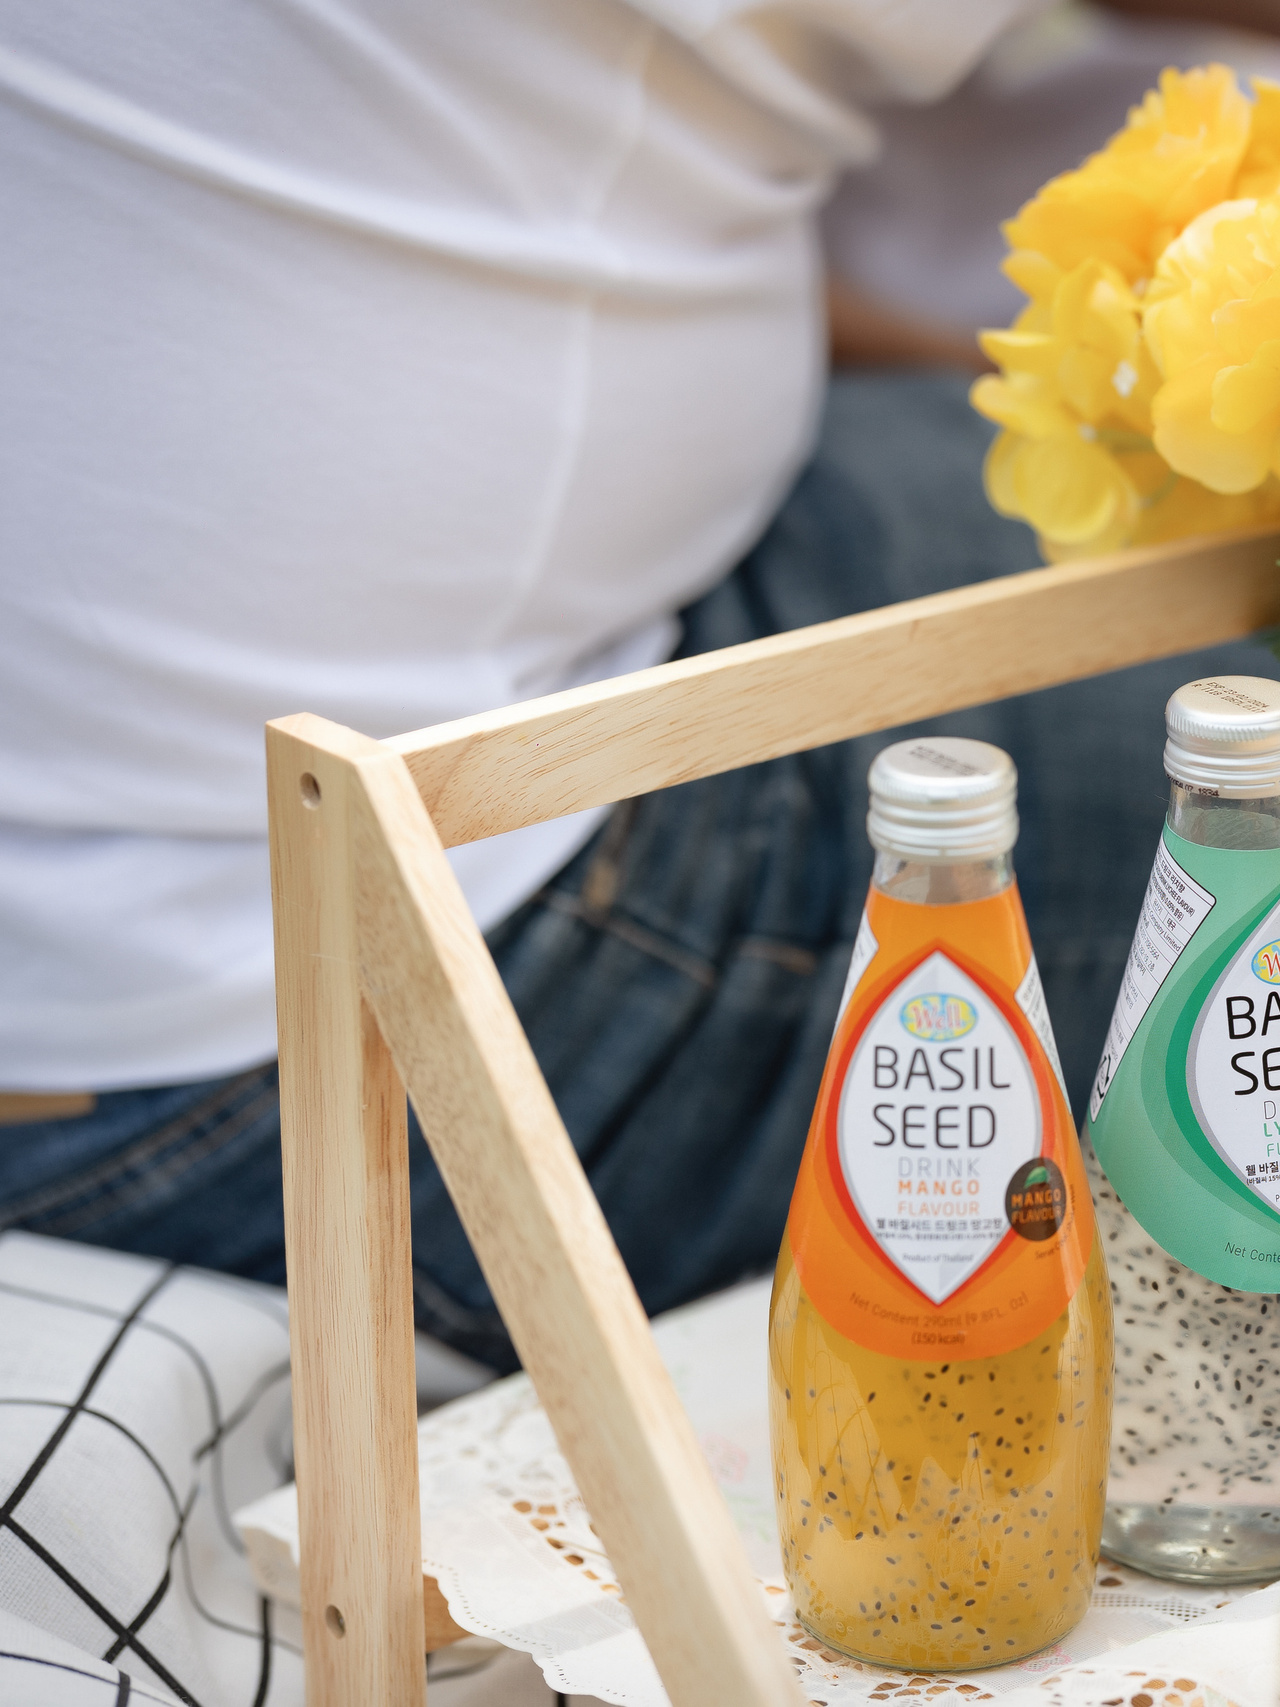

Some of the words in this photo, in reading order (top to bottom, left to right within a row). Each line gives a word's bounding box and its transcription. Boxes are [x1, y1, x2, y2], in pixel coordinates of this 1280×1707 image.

[1163, 931, 1182, 952] Limited
[910, 1001, 963, 1030] Well
[873, 1044, 1011, 1092] BASIL
[873, 1103, 997, 1149] SEED
[897, 1156, 982, 1179] DRINK
[1245, 1163, 1257, 1177] 웰
[897, 1179, 980, 1196] MANGO
[1010, 1187, 1062, 1209] MANGO
[897, 1200, 980, 1217] FLAVOUR
[1011, 1205, 1063, 1225] FLAVOUR
[1224, 1241, 1246, 1259] Net
[849, 1291, 870, 1312] Net
[871, 1303, 919, 1327] Content
[923, 1314, 962, 1328] 290ml
[911, 1331, 936, 1346] (150
